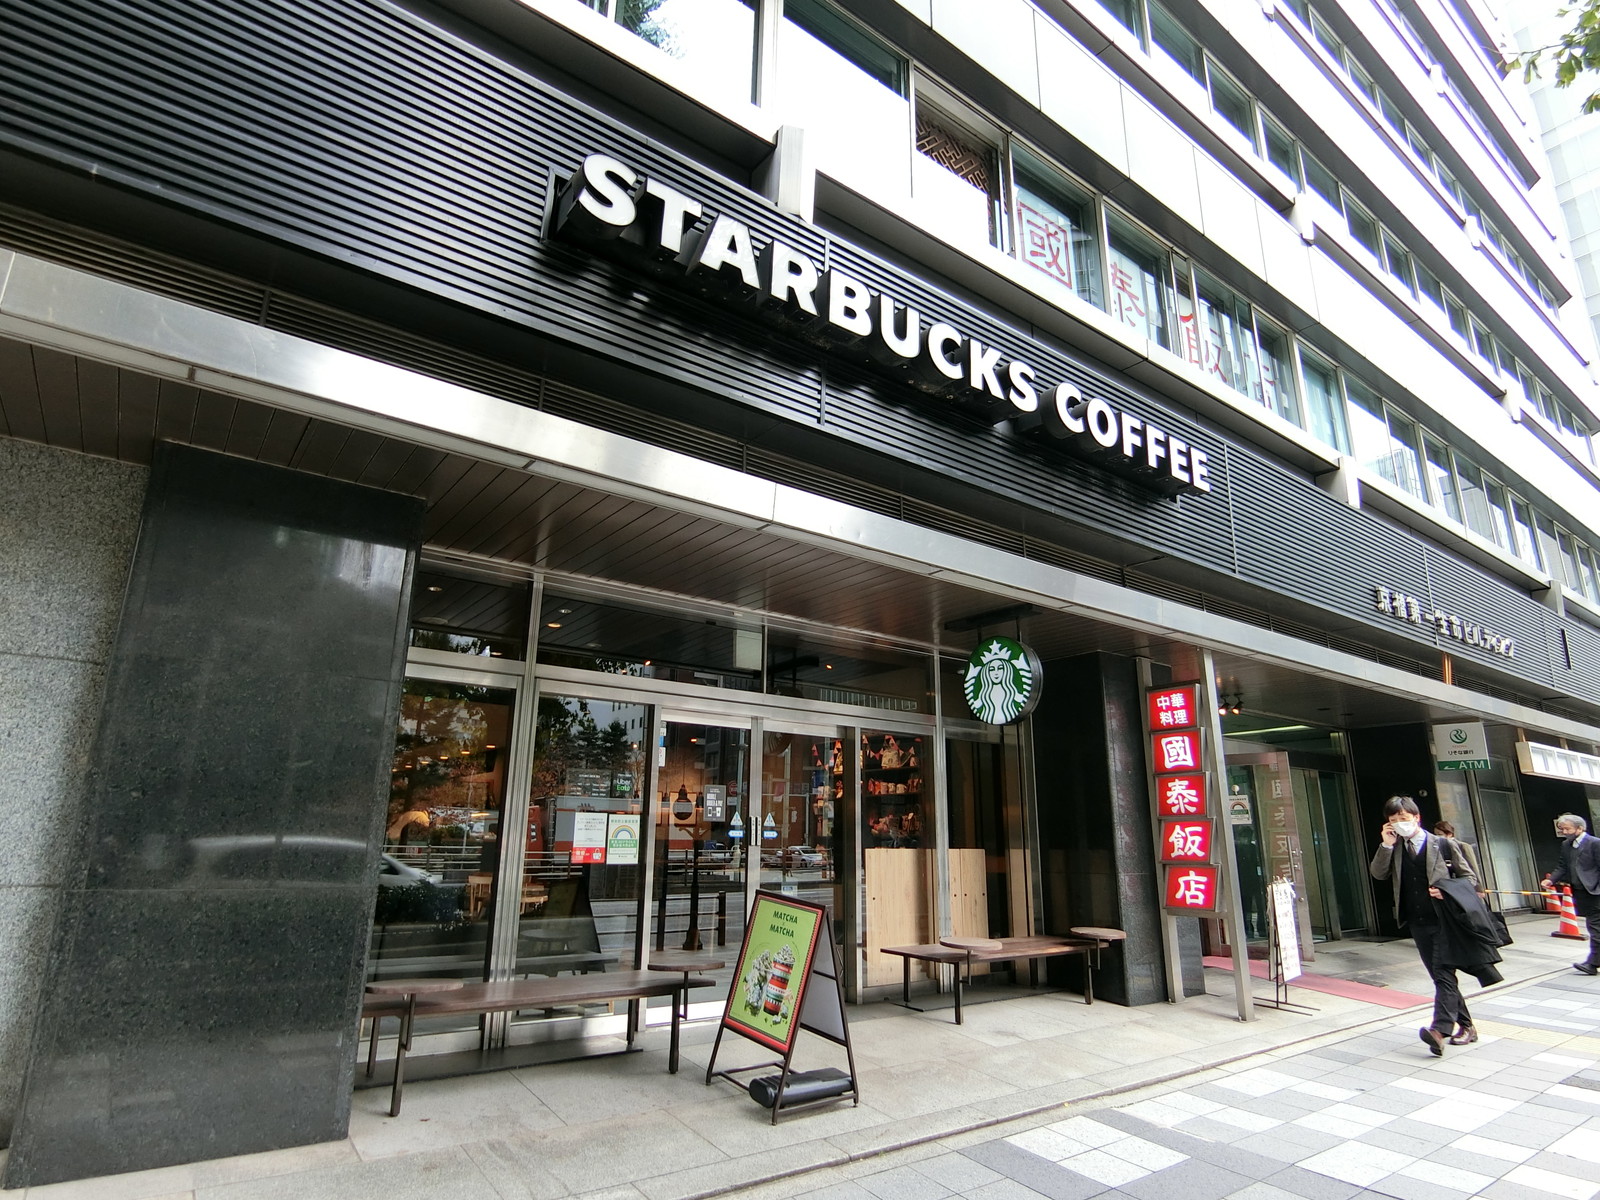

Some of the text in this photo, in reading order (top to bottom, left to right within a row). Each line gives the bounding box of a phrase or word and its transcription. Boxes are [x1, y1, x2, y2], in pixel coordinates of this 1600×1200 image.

[578, 153, 1212, 493] STARBUCKS COFFEE
[1156, 693, 1185, 710] 中華
[1159, 709, 1189, 726] 料理
[1458, 760, 1485, 769] ATM
[1161, 735, 1208, 906] 國泰飯店
[773, 910, 798, 925] MATCHA
[769, 923, 795, 938] MATCHA
